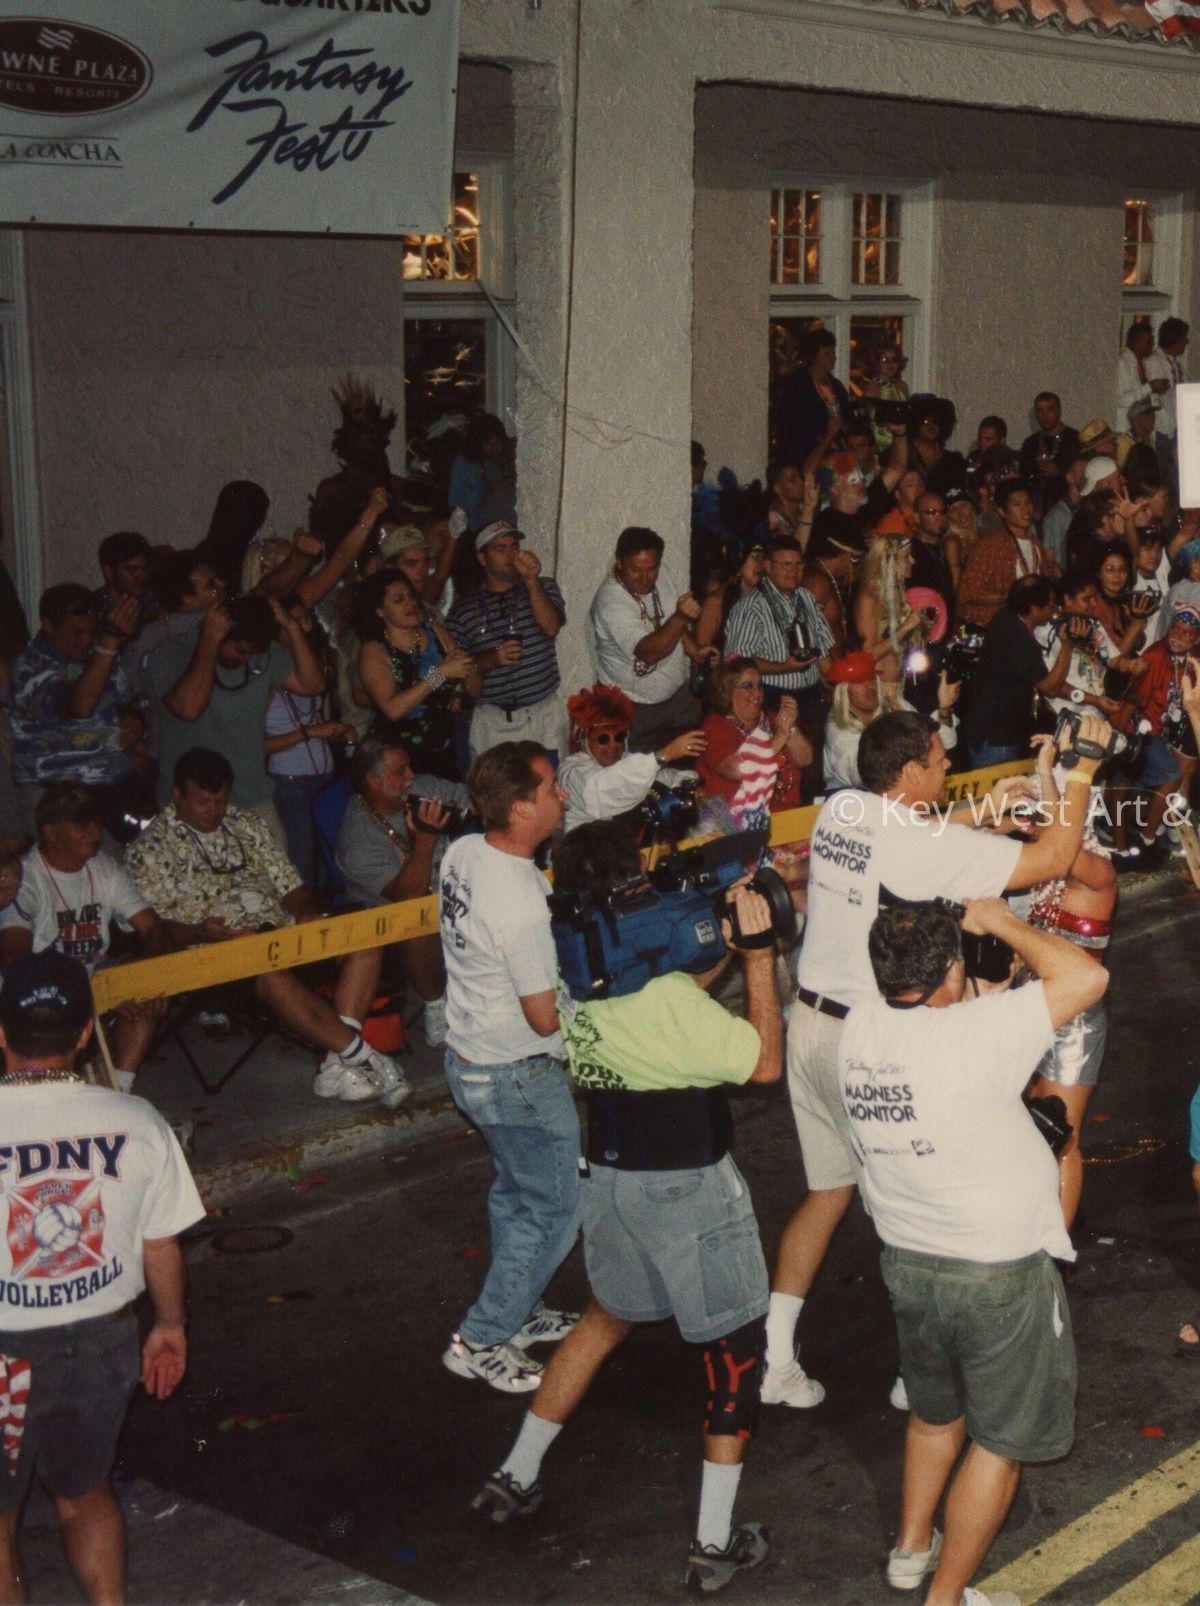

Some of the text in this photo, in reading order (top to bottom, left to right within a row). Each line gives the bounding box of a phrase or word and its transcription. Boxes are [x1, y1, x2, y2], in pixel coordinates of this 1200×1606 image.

[75, 59, 138, 82] PLAZA
[54, 85, 120, 98] RESORTS
[187, 31, 414, 150] Fantasy
[26, 142, 122, 162] CONCHA
[212, 98, 396, 205] Fest
[815, 826, 873, 860] MADNESS
[812, 842, 867, 876] MONITOR
[845, 1083, 913, 1102] MADNESS
[848, 1103, 917, 1122] MONITOR
